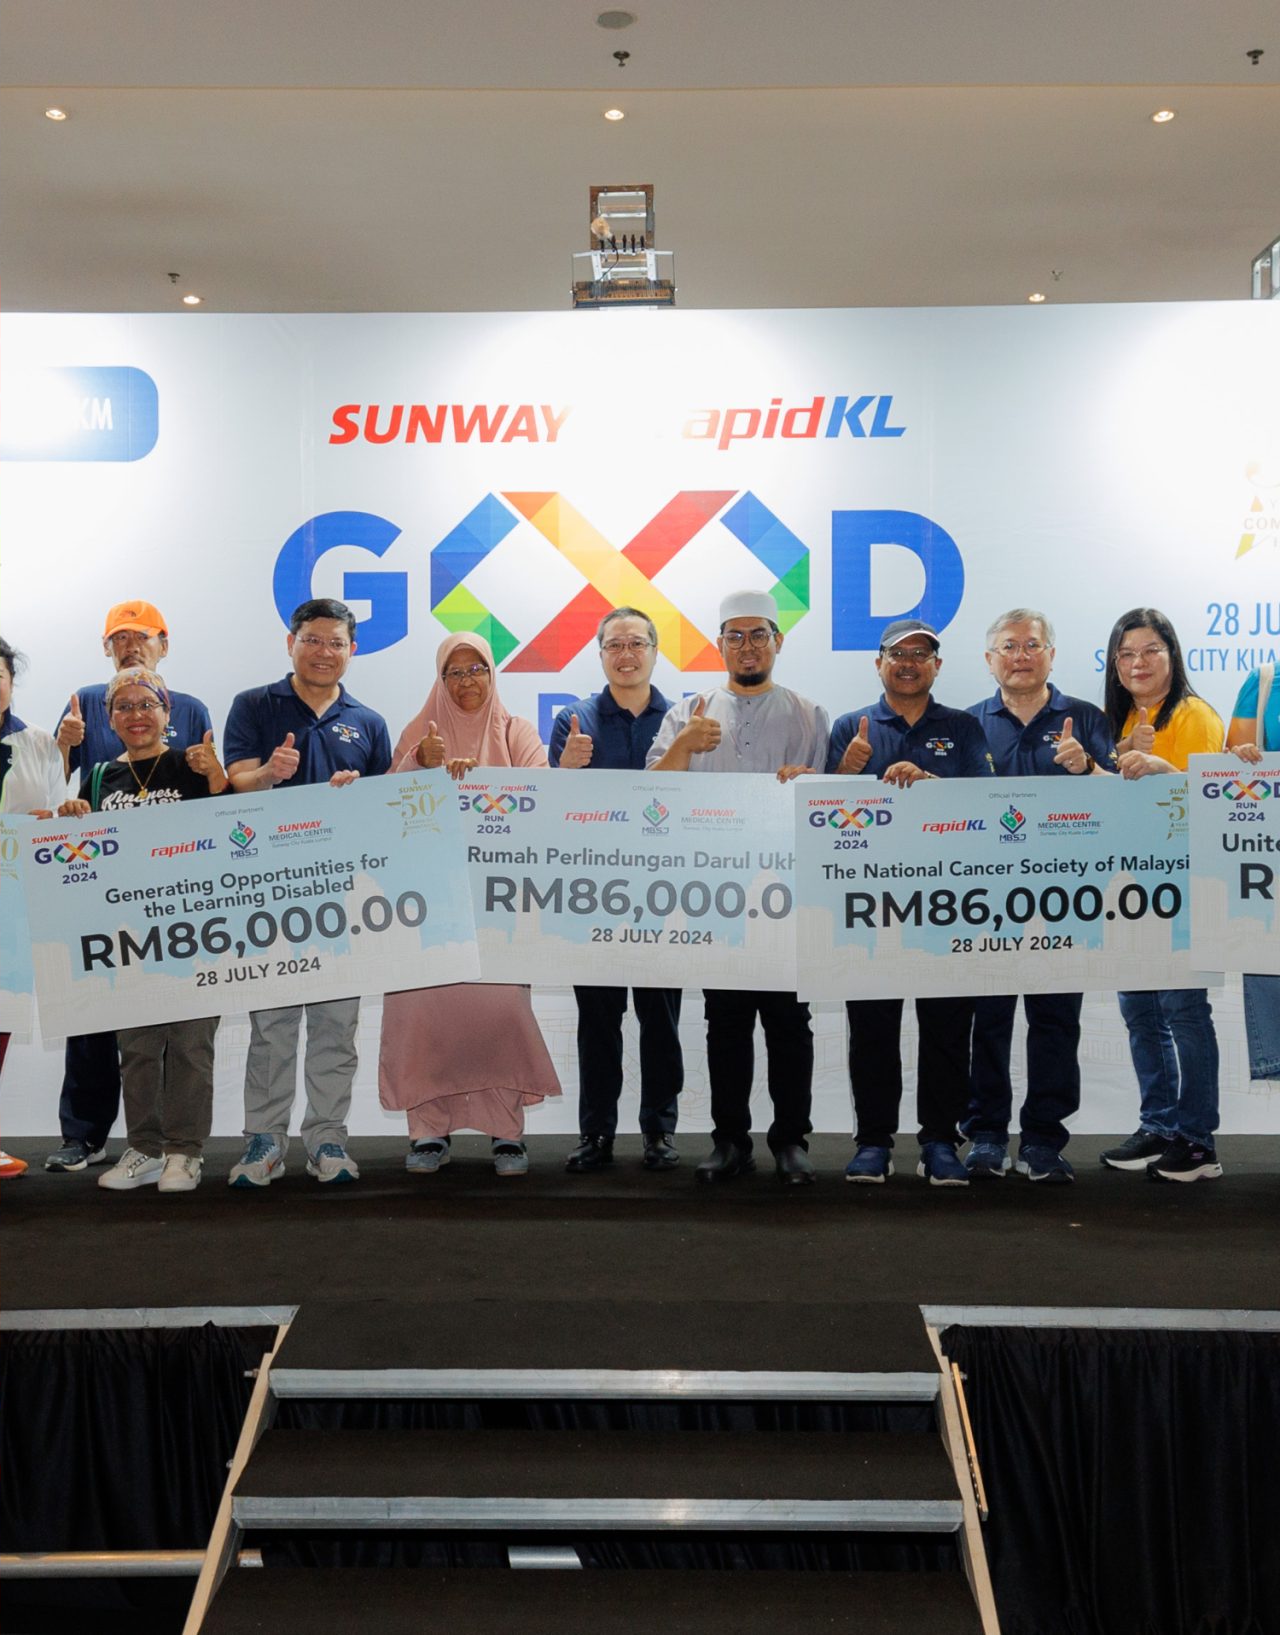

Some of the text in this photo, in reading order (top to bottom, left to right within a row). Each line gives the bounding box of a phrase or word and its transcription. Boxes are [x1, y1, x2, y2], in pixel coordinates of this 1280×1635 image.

[329, 395, 907, 450] SUNWAY apidKL
[1206, 602, 1240, 637] 28
[1187, 648, 1230, 673] CITY
[500, 784, 538, 793] rapidKL
[401, 792, 436, 819] 50
[807, 797, 895, 807] SUNWAY rapidKL
[564, 809, 631, 824] rapidKL
[690, 808, 737, 817] SUNWAY
[1047, 812, 1091, 822] SUNWAY
[1228, 812, 1265, 822] 2024
[268, 827, 333, 842] MEDICAL CENTRE
[277, 820, 322, 833] SUNWAY
[476, 824, 511, 835] 2024
[921, 819, 987, 835] rapidKL
[31, 827, 119, 844] SUNWAY rapidKL
[999, 833, 1027, 842] MBSJ
[150, 838, 217, 858] rapidKL
[230, 848, 259, 858] MBSJ
[833, 840, 869, 850] 2024
[68, 862, 89, 871] RUN
[467, 845, 539, 865] Rumah
[546, 847, 686, 873] Perlindungan
[694, 851, 750, 870] Darul
[821, 853, 1190, 881] The National Cancer Society of Malaysi
[62, 871, 98, 885] 2024
[105, 854, 389, 905] Generating Opportunities for
[144, 876, 355, 918] the Learning Disabled
[485, 875, 793, 923] RM86,000.0
[844, 882, 1183, 932] RM86,000.00
[80, 890, 428, 972] RM86,000.00
[591, 928, 713, 945] 28 JULY 2024
[951, 935, 1073, 953] 28 JULY 2024
[196, 957, 322, 988] 28 JULY 2024
